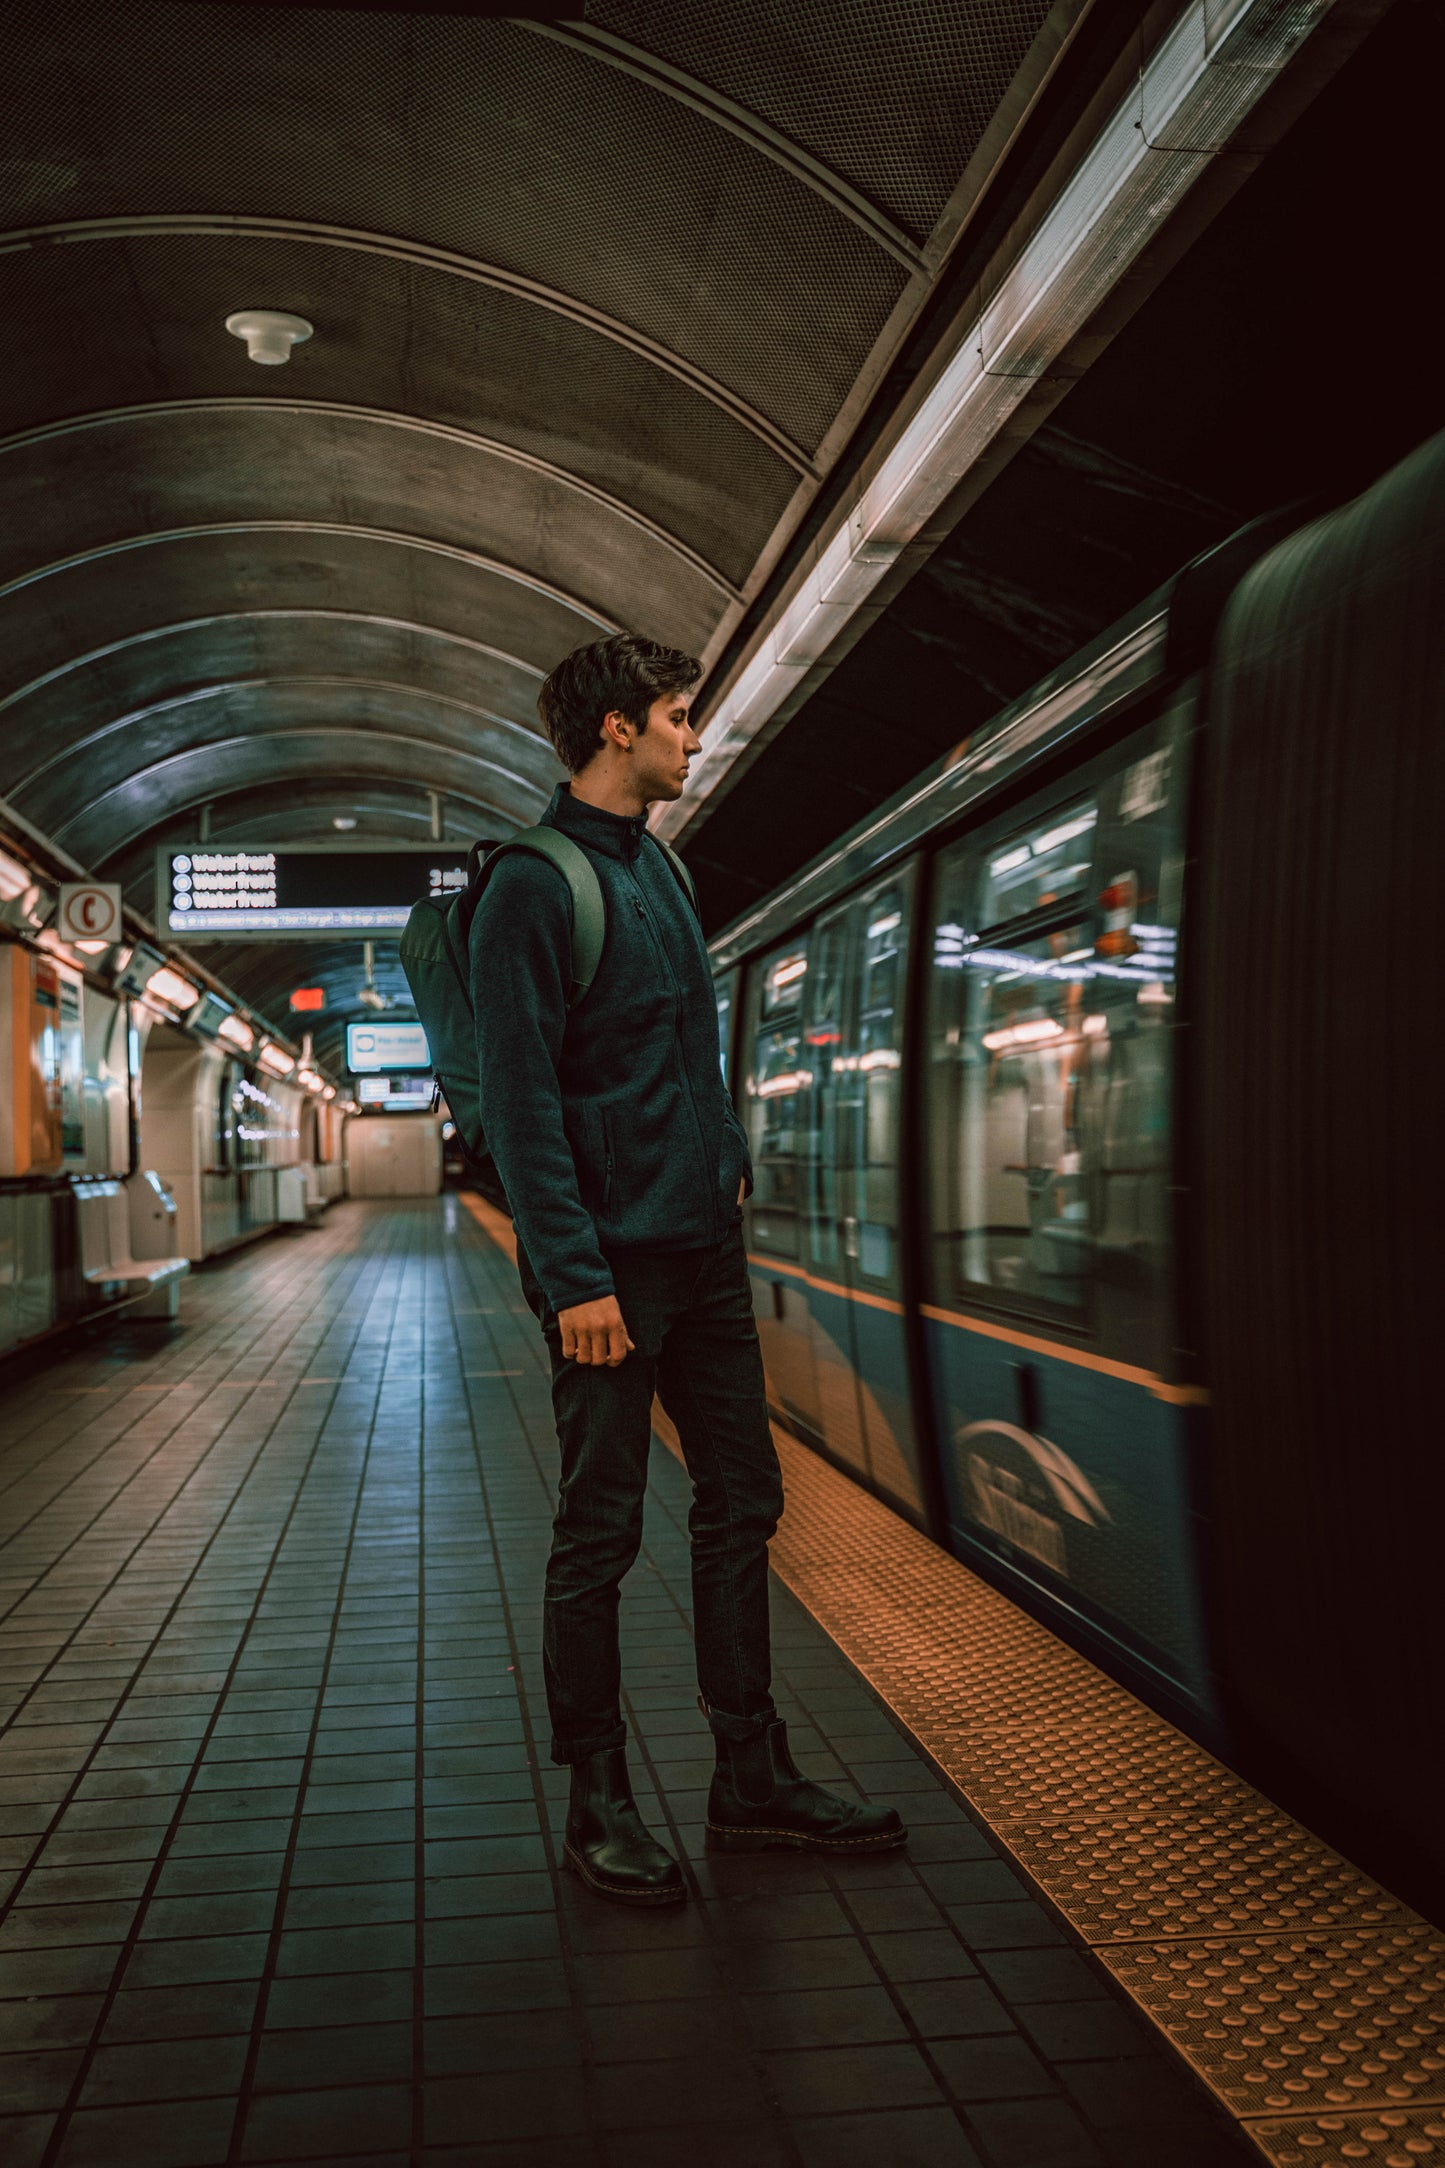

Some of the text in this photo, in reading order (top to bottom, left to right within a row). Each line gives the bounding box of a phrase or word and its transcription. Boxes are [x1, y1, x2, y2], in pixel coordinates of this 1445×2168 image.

[192, 853, 275, 871] Waterfront
[192, 872, 276, 889] Waterfront
[430, 869, 442, 886] 3
[193, 890, 276, 908] Waterfront
